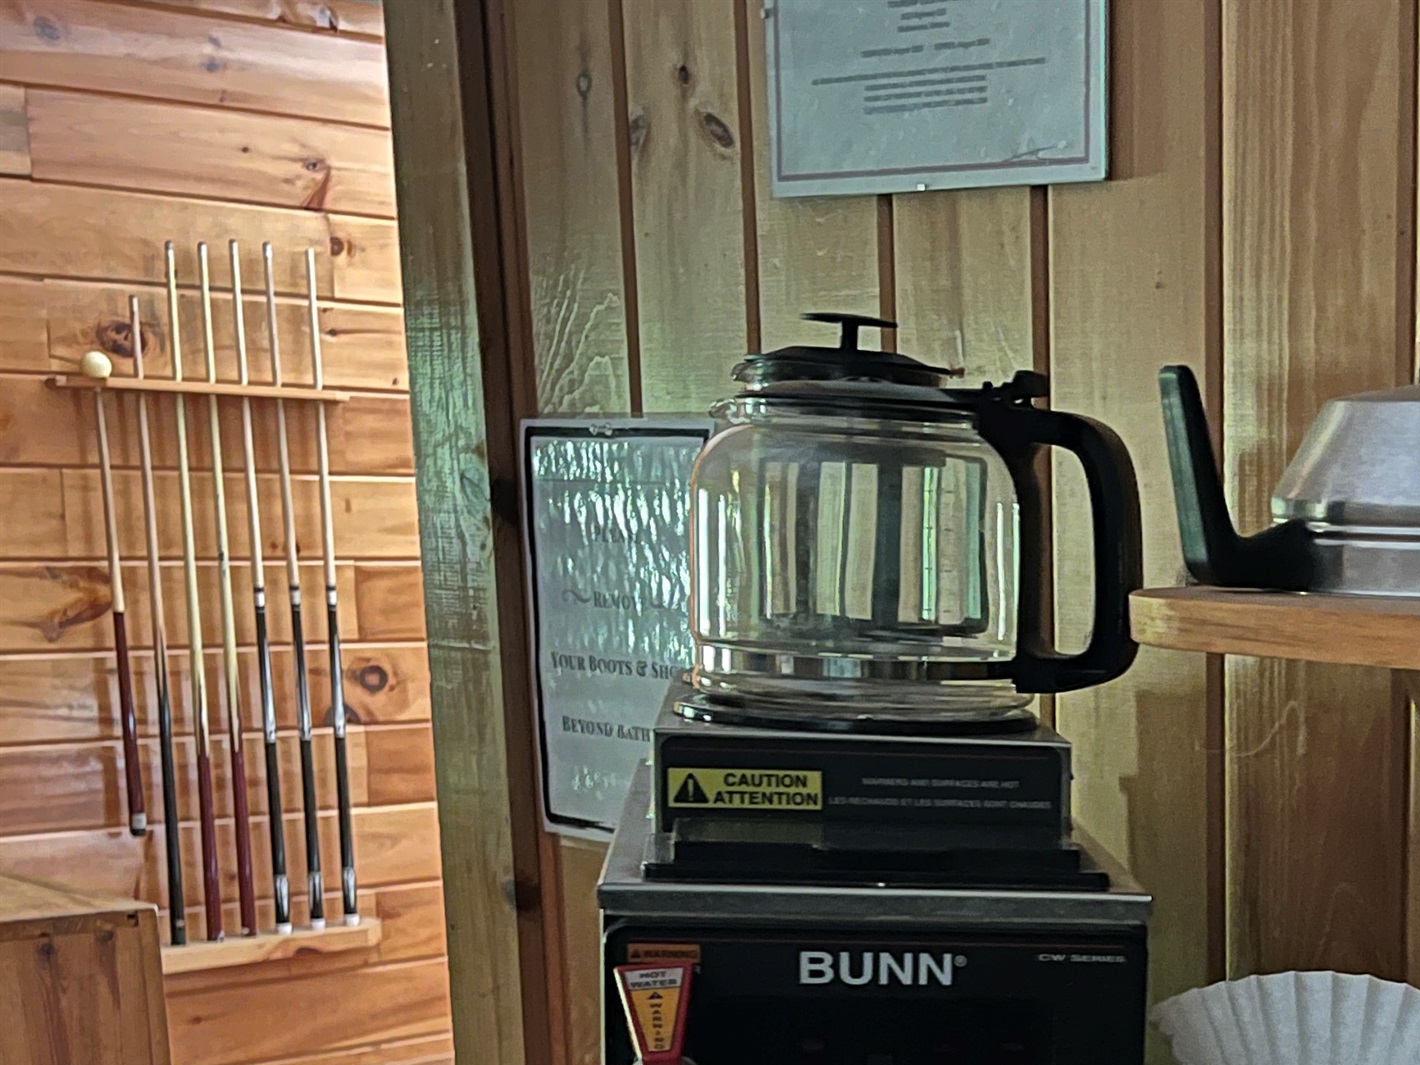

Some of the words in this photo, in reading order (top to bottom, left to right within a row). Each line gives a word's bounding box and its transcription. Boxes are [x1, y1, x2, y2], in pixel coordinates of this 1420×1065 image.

[551, 651, 586, 672] YOUR
[589, 655, 633, 676] BOOTS
[636, 660, 649, 677] &
[651, 663, 676, 680] SHO
[562, 715, 614, 737] BEYOND
[723, 773, 808, 789] CAUTION
[713, 790, 819, 807] ATTENTION
[1038, 953, 1067, 962] CW
[1070, 954, 1126, 963] SERIES
[640, 970, 667, 979] HOT
[798, 950, 953, 986] BUNN
[630, 978, 677, 988] WATER
